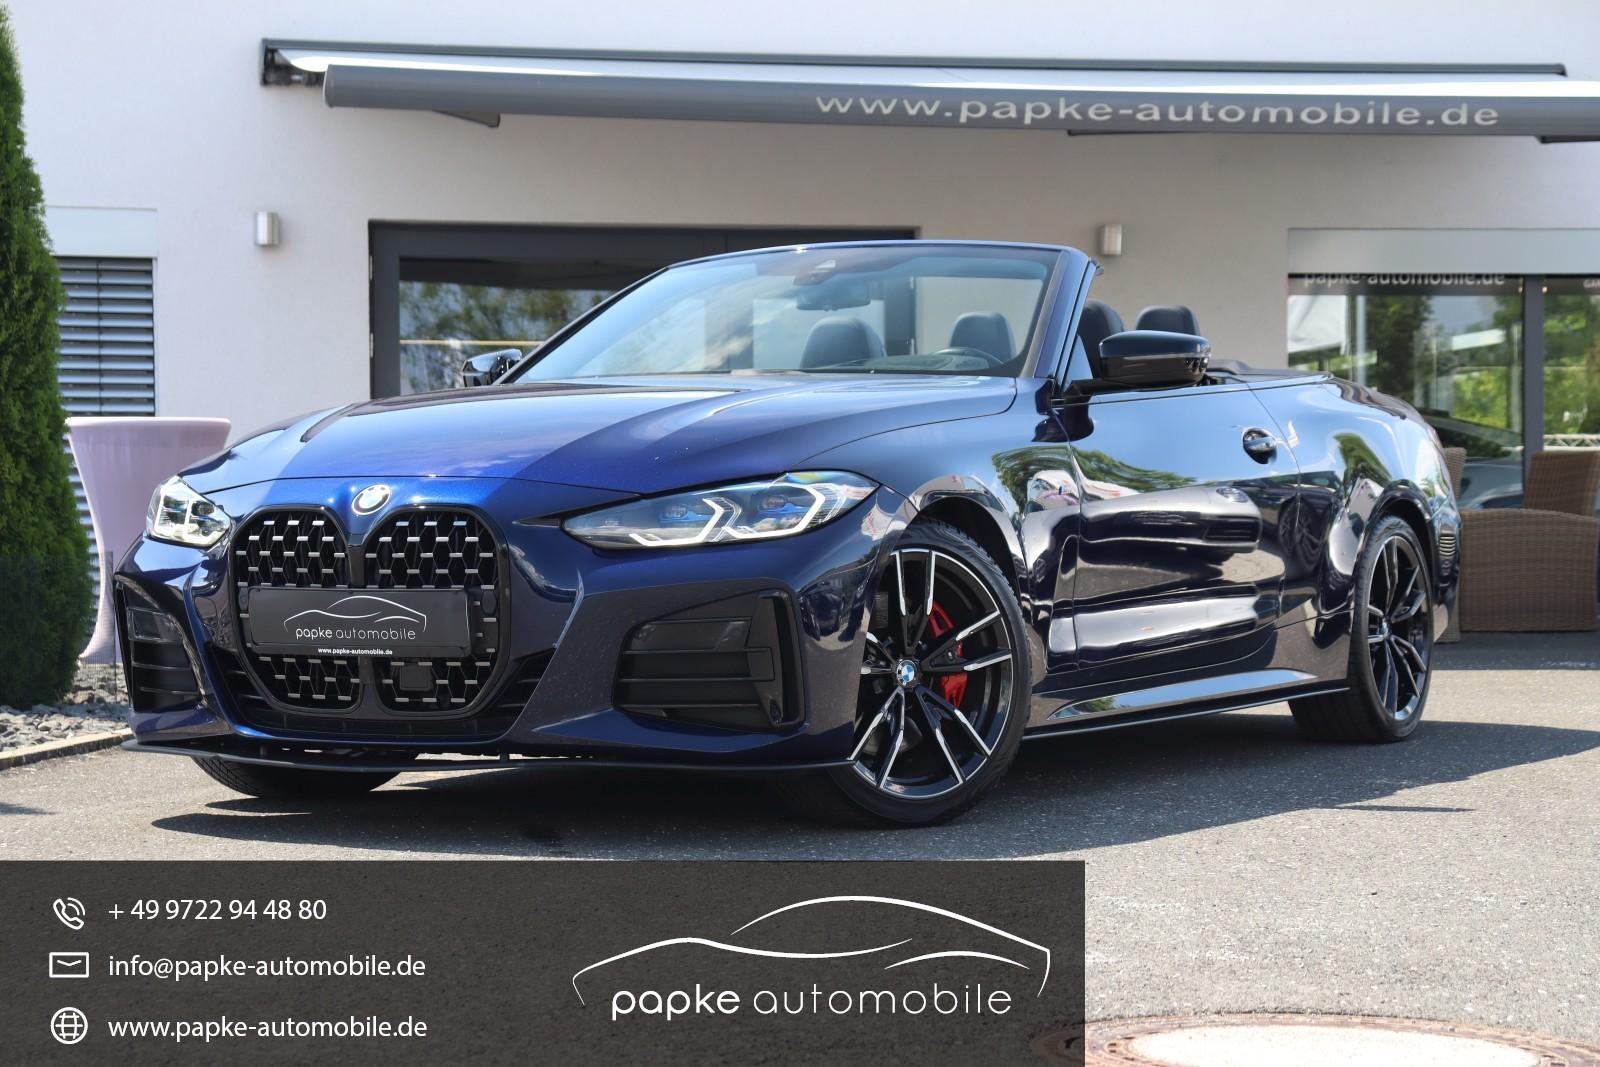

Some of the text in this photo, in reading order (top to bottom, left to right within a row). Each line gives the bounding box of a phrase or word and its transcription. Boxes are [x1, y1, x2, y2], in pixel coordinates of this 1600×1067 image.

[815, 97, 1500, 126] www.papke-automobile.de
[295, 627, 416, 640] papke automobile
[317, 647, 393, 656] www.papke-automobile.de
